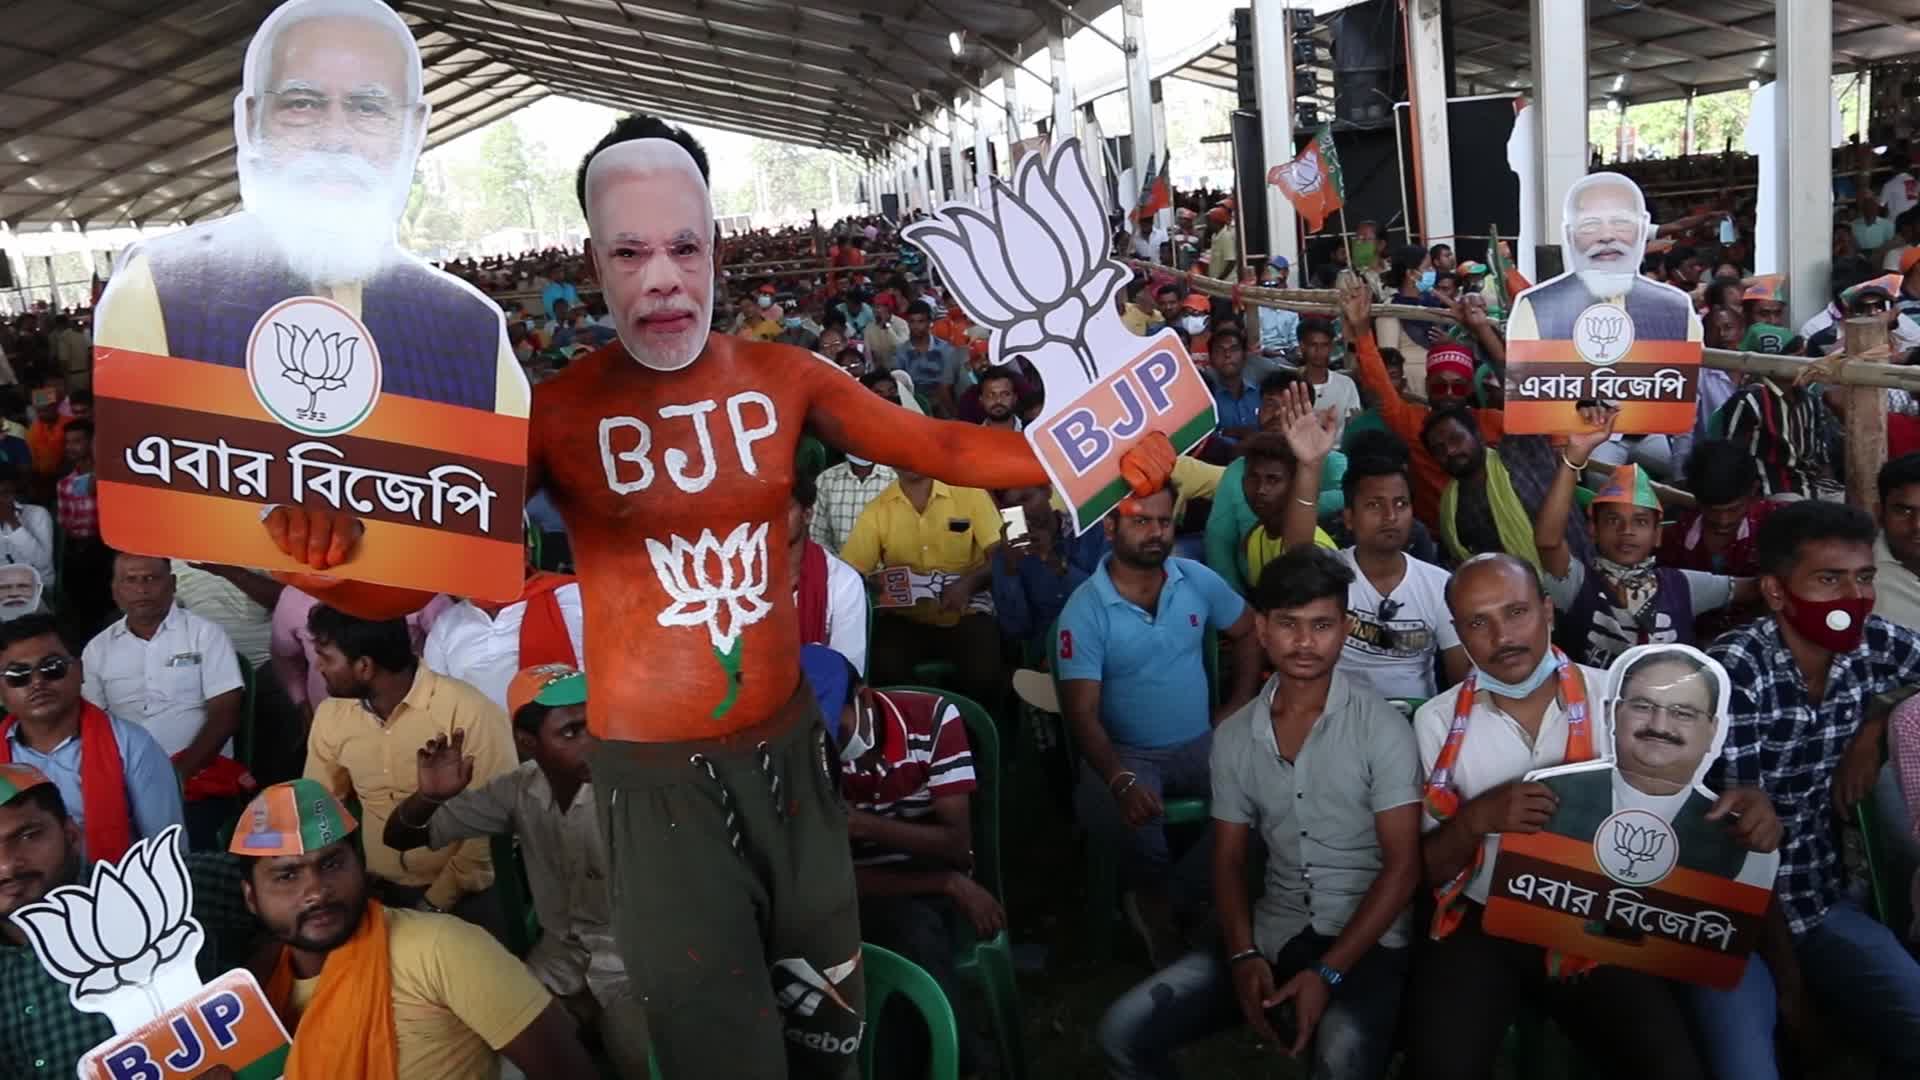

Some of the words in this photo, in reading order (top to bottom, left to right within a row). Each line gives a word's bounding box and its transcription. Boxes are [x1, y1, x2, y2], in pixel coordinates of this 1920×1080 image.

[1047, 349, 1180, 478] BJP
[1519, 373, 1585, 399] এবার
[1590, 367, 1688, 400] বিজেপি
[124, 433, 274, 499] এবার
[287, 440, 499, 533] বিজেপি
[598, 390, 778, 495] BJP
[887, 570, 909, 602] BJP
[1060, 629, 1073, 659] 3
[1507, 873, 1599, 916] এবার
[1604, 887, 1737, 951] বিজেপি
[101, 990, 245, 1080] BJP
